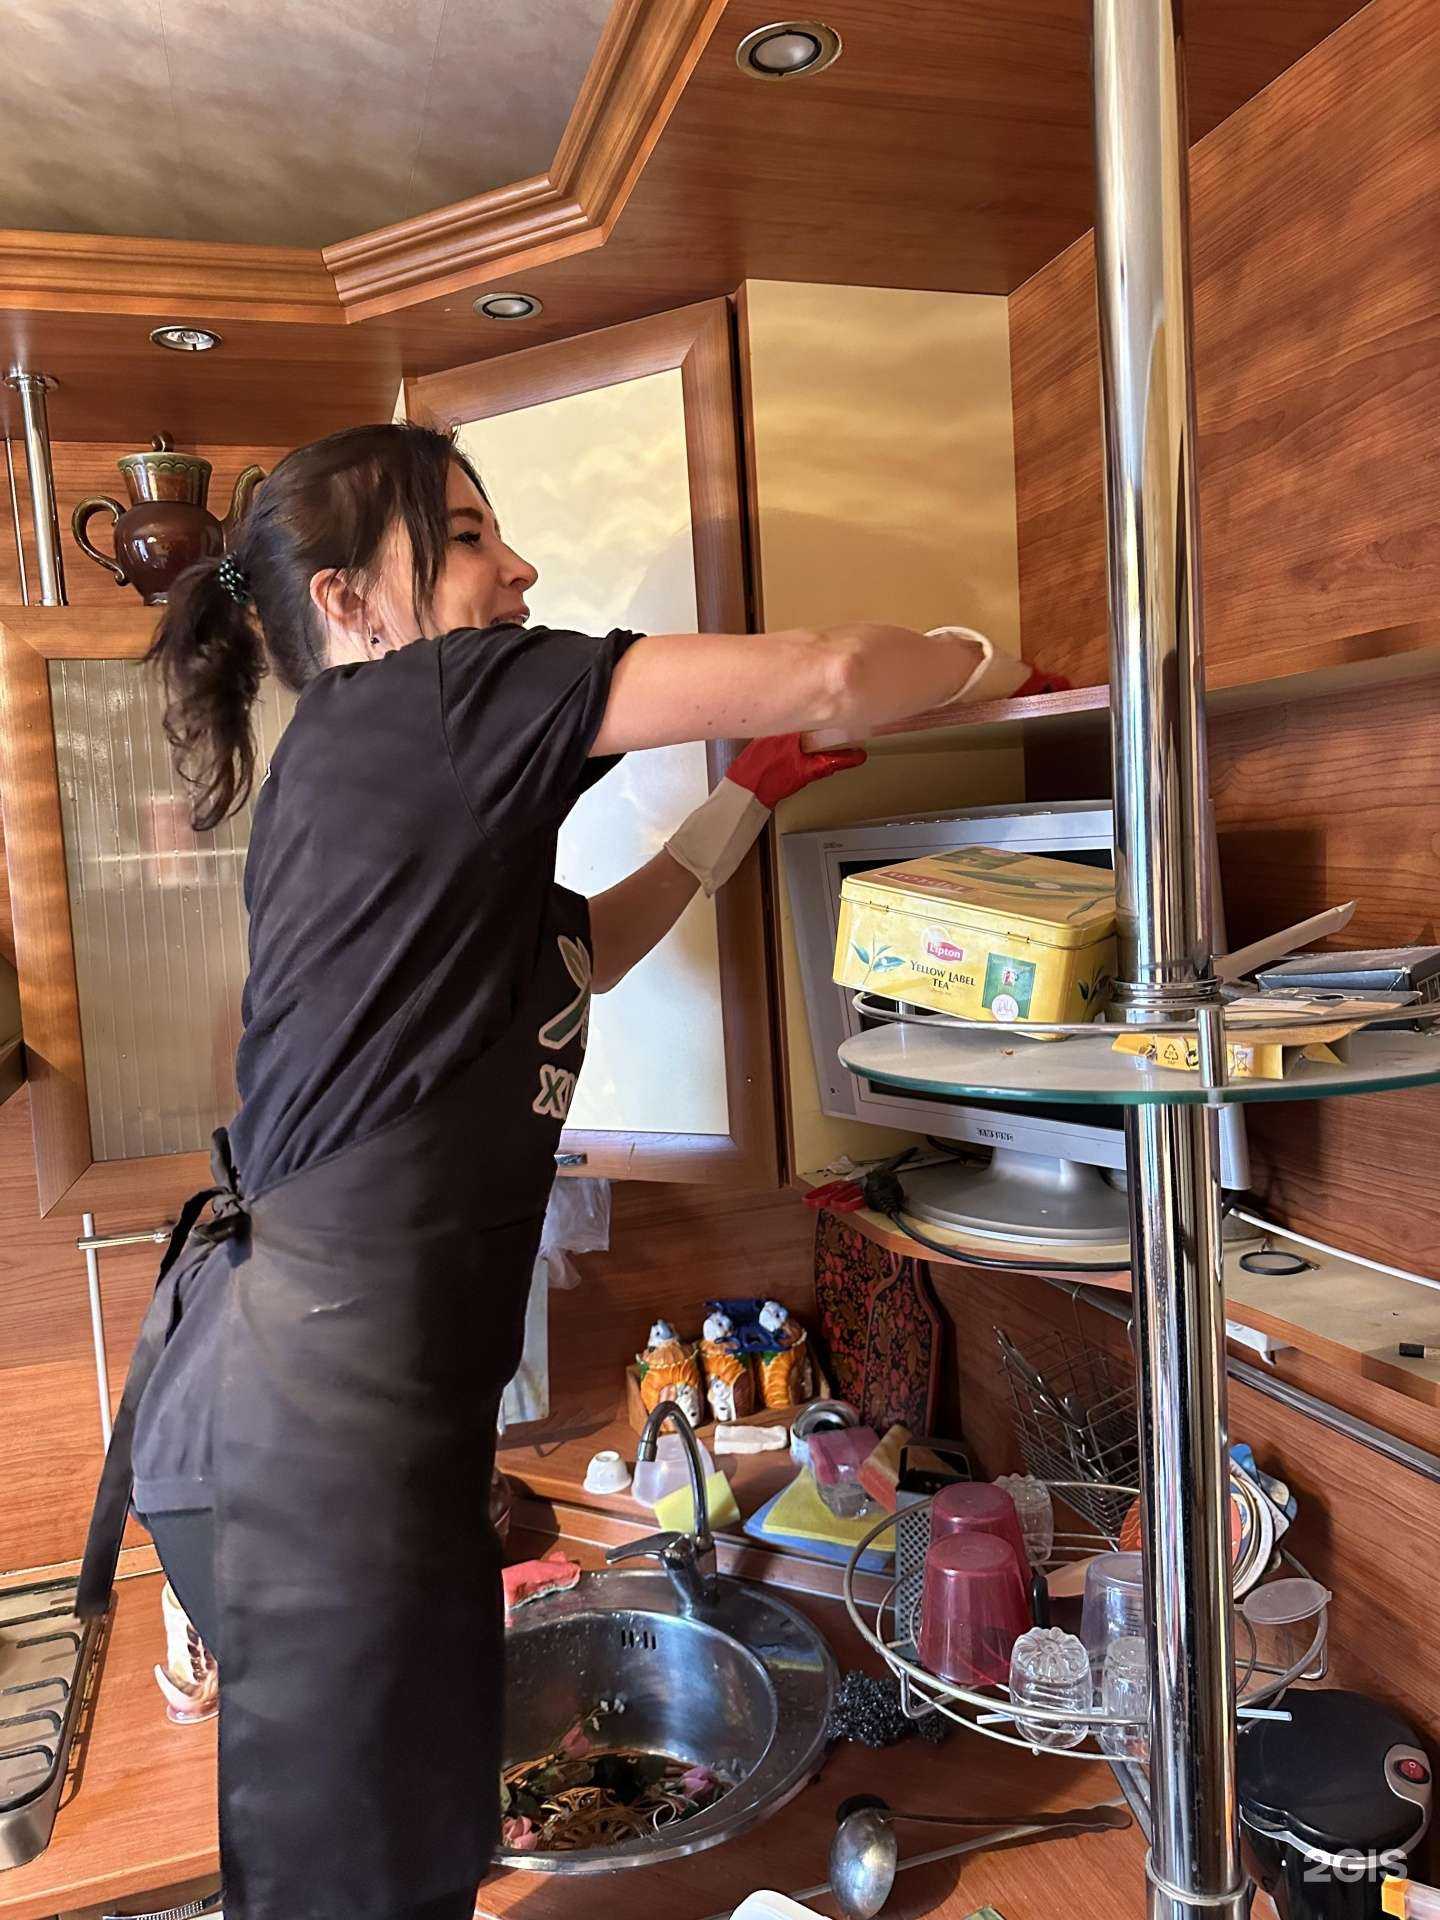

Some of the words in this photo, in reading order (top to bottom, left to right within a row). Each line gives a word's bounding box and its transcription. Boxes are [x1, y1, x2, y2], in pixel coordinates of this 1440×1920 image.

[929, 944, 961, 959] Lipton
[910, 960, 946, 978] YELLOW
[948, 972, 976, 986] LABEL
[932, 978, 949, 990] TEA
